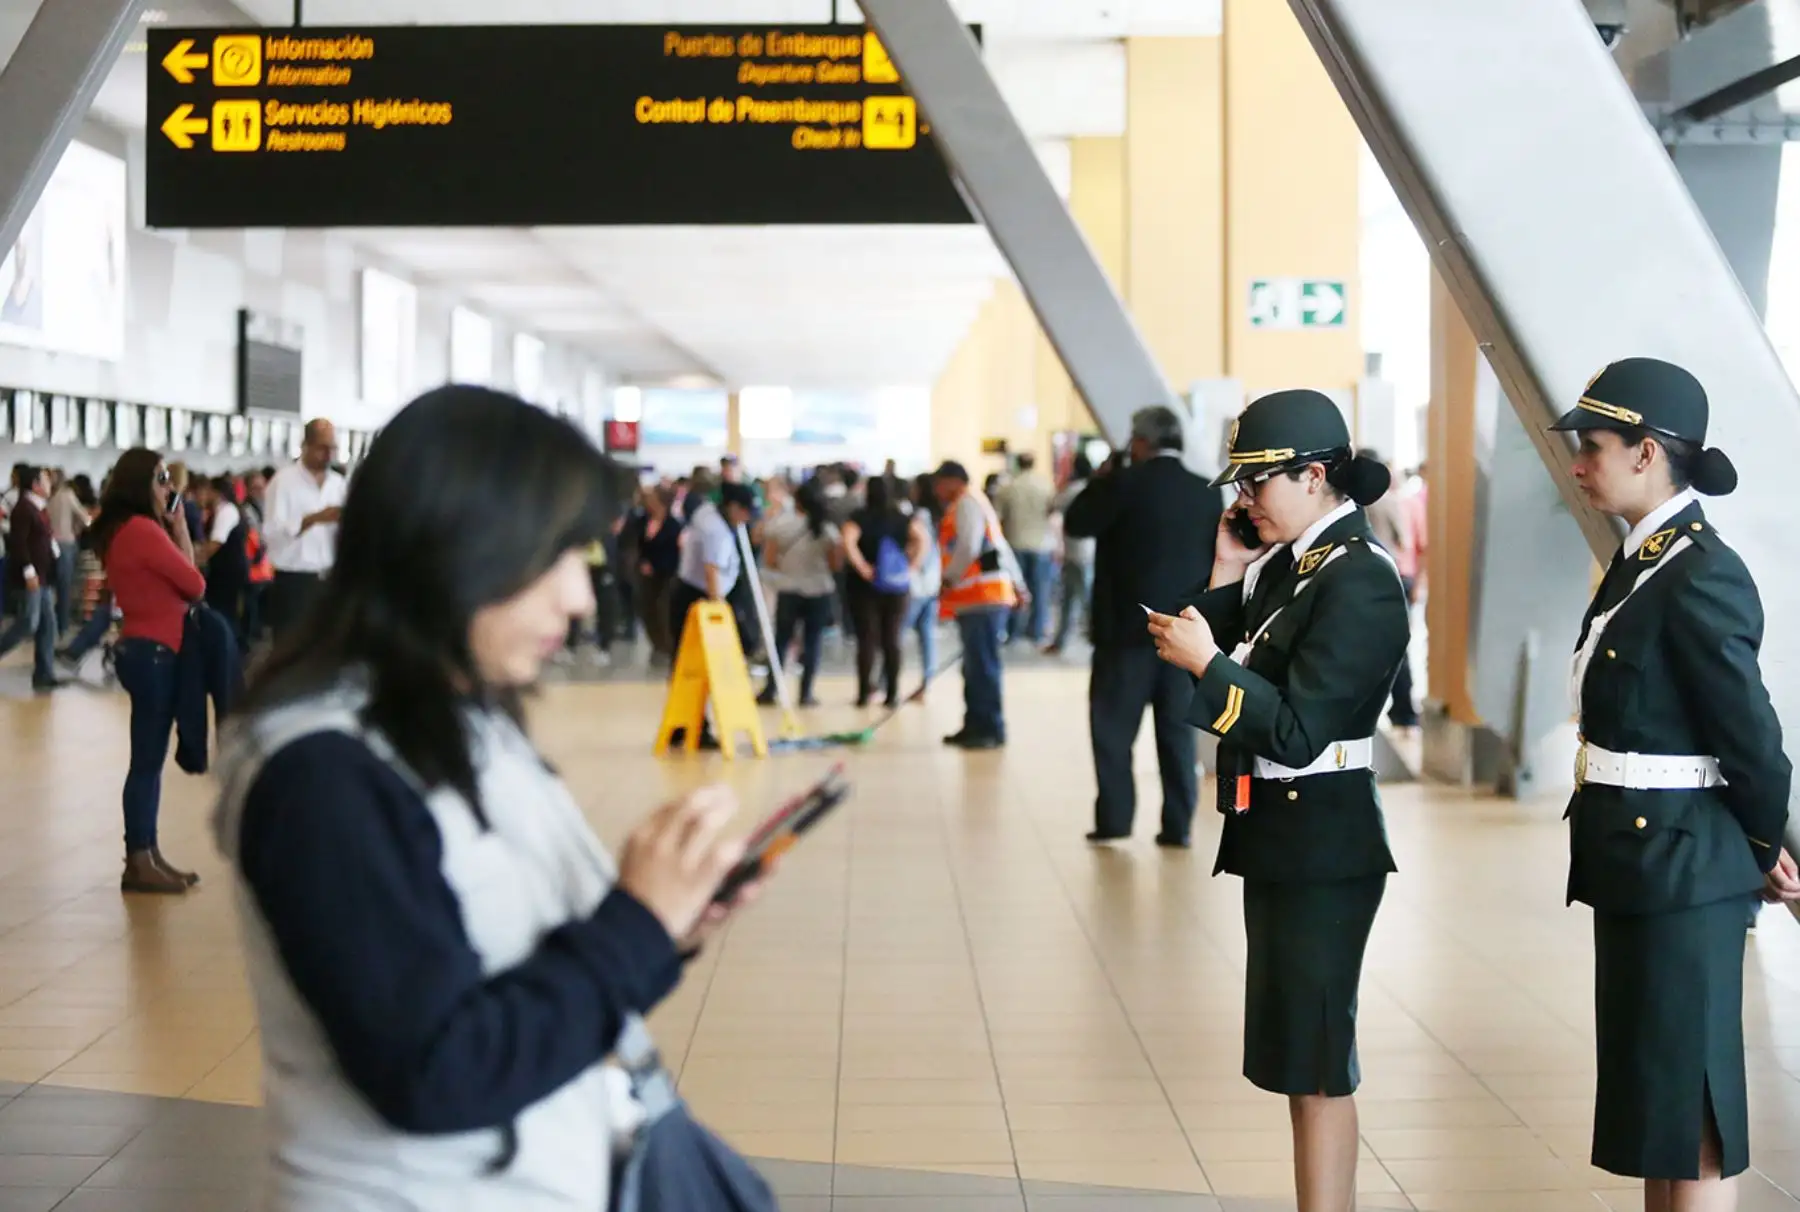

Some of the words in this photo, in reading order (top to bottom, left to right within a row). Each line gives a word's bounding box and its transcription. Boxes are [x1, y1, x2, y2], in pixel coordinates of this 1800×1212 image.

[265, 35, 373, 60] Información
[665, 32, 735, 57] Puertas
[738, 34, 763, 57] de
[765, 32, 861, 59] Embarque
[267, 65, 351, 85] Information
[738, 62, 814, 85] Departure
[815, 61, 861, 84] Gates
[265, 99, 349, 126] Servicios
[352, 98, 452, 128] Higiénicos
[635, 96, 706, 123] Control
[707, 97, 735, 123] de
[735, 96, 861, 125] Preembarque
[267, 129, 346, 151] Restrooms
[791, 126, 841, 150] Check
